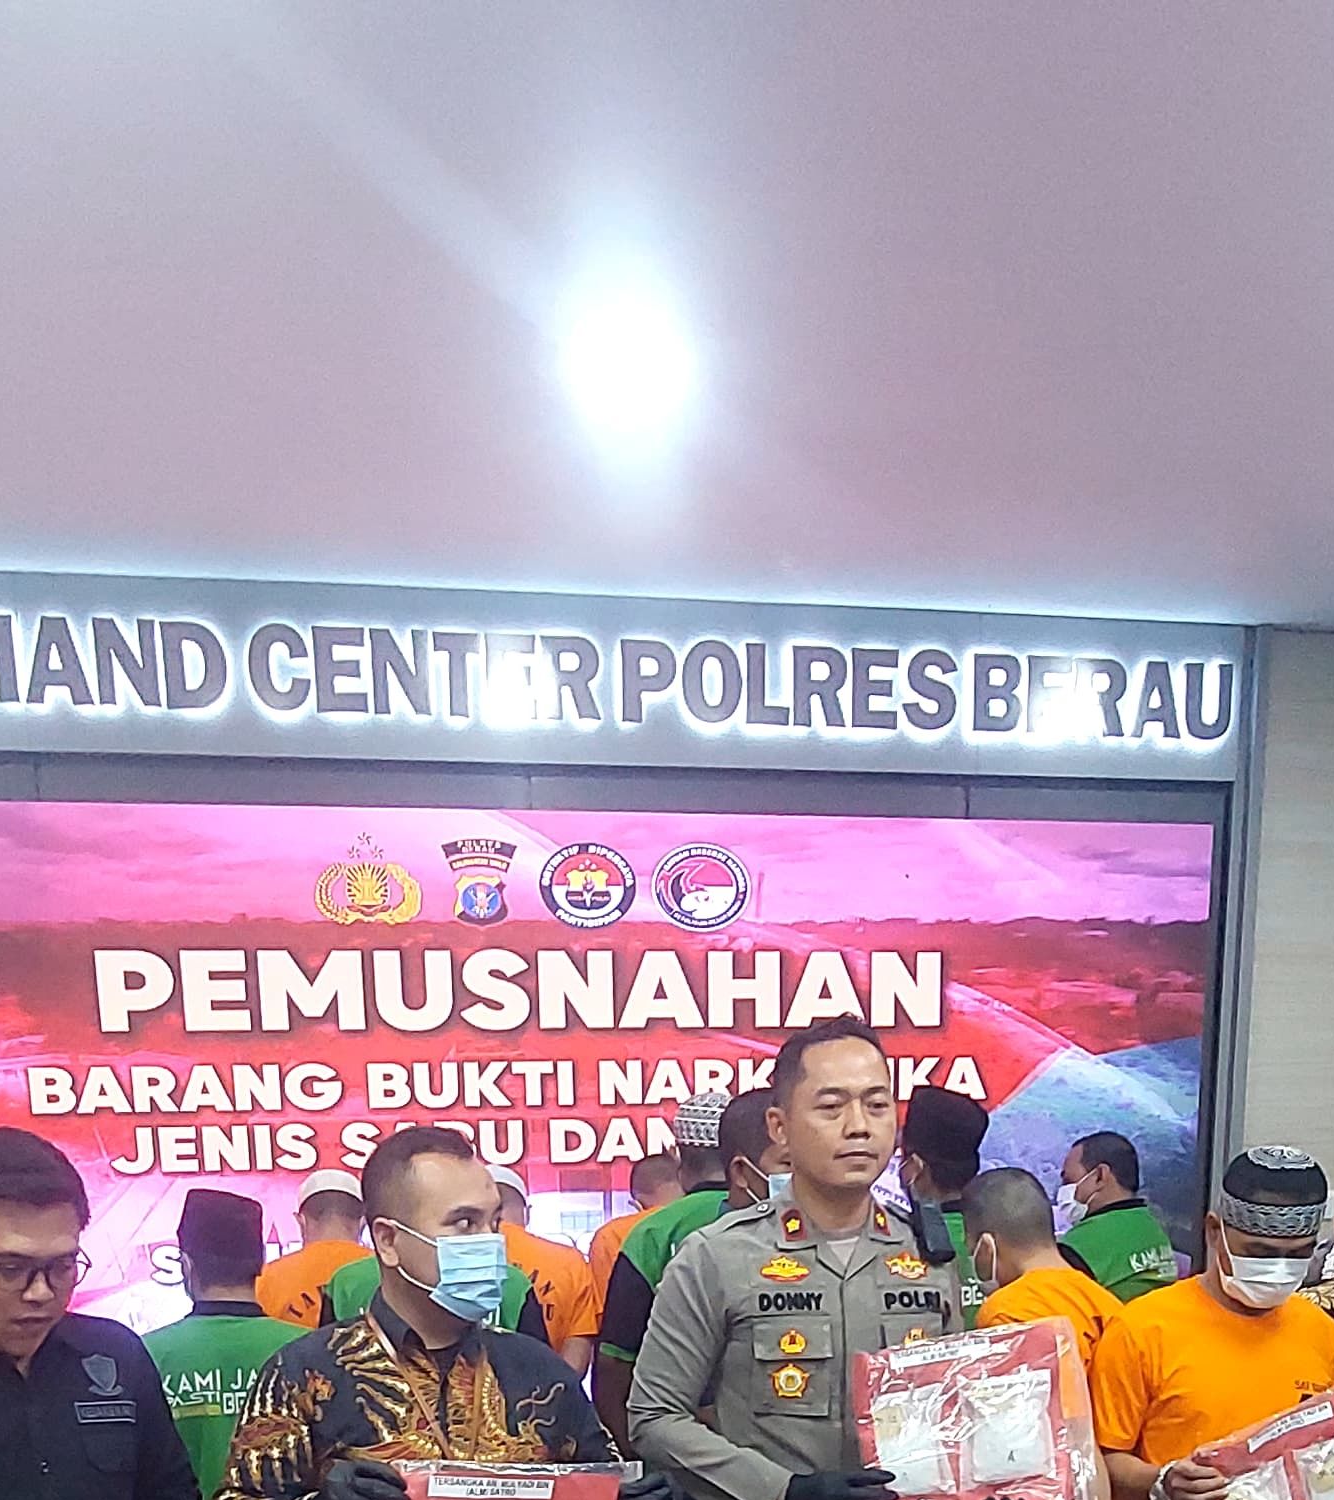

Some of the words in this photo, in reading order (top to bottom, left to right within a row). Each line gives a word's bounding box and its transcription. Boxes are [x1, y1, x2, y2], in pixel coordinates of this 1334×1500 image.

[620, 638, 958, 732] POLRES
[971, 652, 1234, 742] BERAU
[93, 948, 944, 1034] PEMUSNAHAN
[28, 1062, 343, 1116] BARANG
[366, 1060, 574, 1109] BUKTI
[598, 1056, 987, 1105] NARKKA
[111, 1123, 317, 1175] JENIS
[340, 1120, 525, 1170] SU
[548, 1117, 677, 1164] DAN
[758, 1292, 824, 1312] DONNY
[883, 1291, 942, 1310] POLRI
[162, 1368, 221, 1396] KAMI
